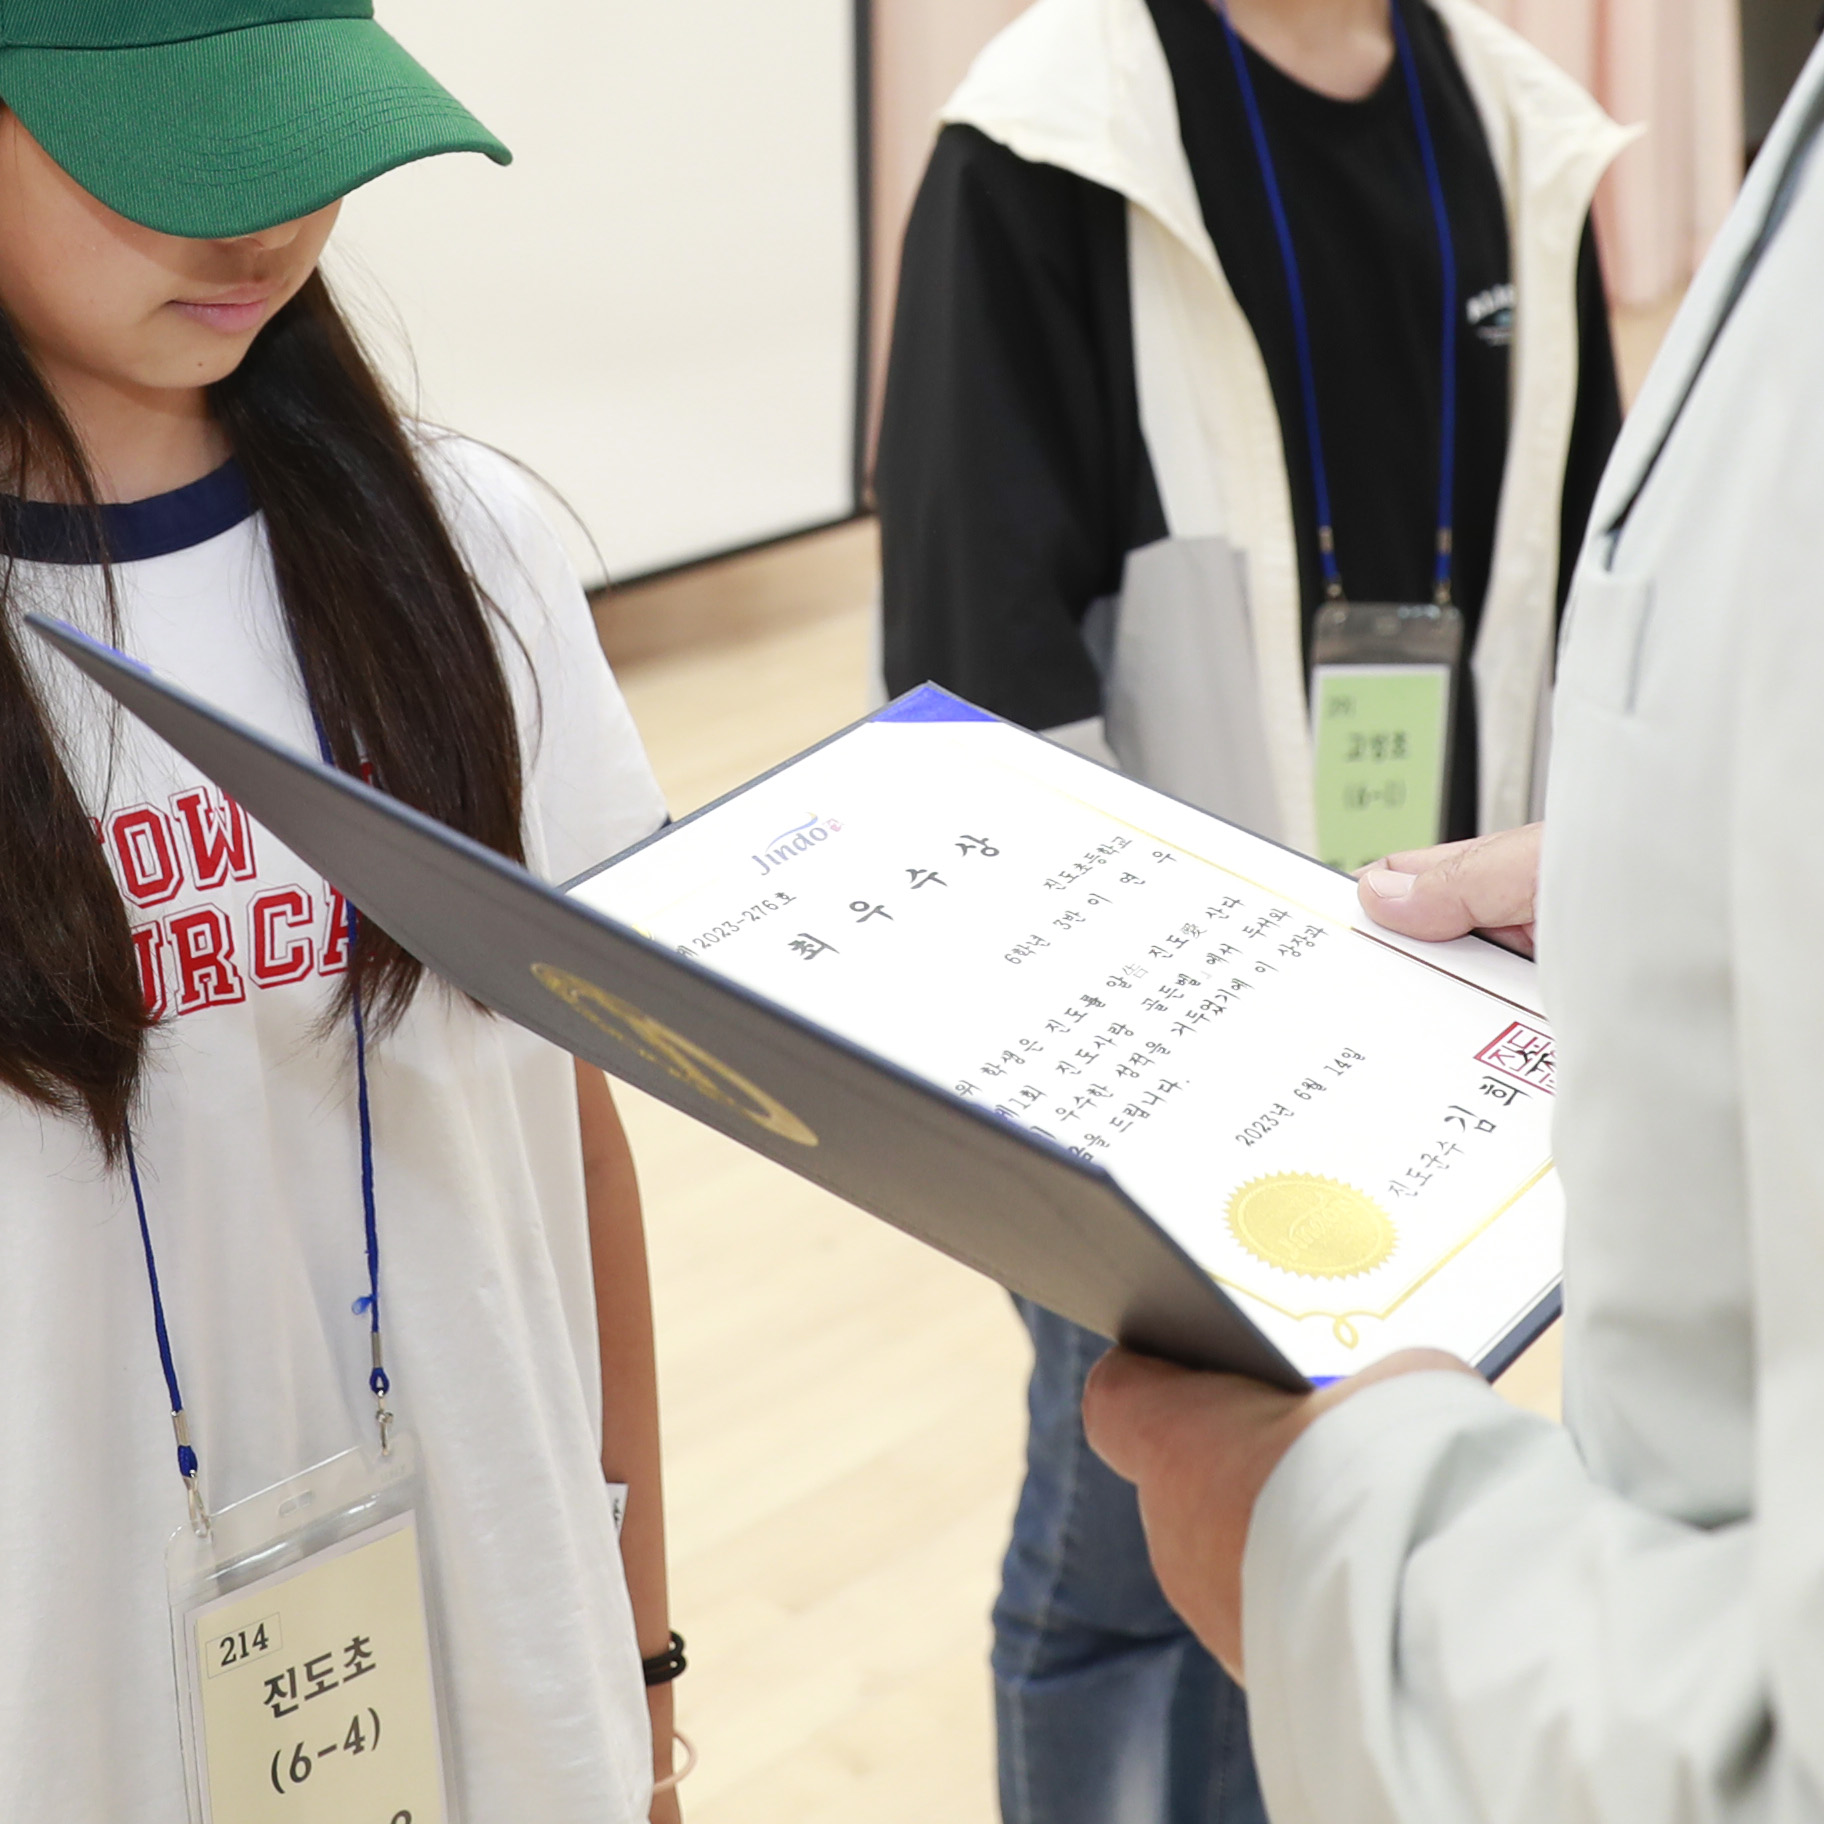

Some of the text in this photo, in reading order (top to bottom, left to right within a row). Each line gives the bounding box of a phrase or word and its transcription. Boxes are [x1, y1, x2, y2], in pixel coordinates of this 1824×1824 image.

[88, 786, 257, 909] OW
[752, 826, 828, 876] Jindo
[1043, 836, 1132, 890] 진도초등학교
[1004, 935, 1051, 964] 6학년
[1052, 910, 1086, 930] 3반
[980, 1039, 1044, 1076] 학생은
[1045, 994, 1106, 1033] 진도를
[1205, 896, 1245, 919] 산다
[1055, 925, 1328, 1121] 우수한 성적을 거두었기에 이 상장과
[1055, 1022, 1134, 1075] 진도사랑
[1109, 1079, 1190, 1133] 드립니다.
[1235, 1048, 1365, 1146] 2023년 6월 14일
[1389, 1141, 1461, 1196] 진도군수
[219, 1623, 270, 1667] 214
[263, 1635, 376, 1718] 진도초
[271, 1707, 380, 1794] (6-4)
